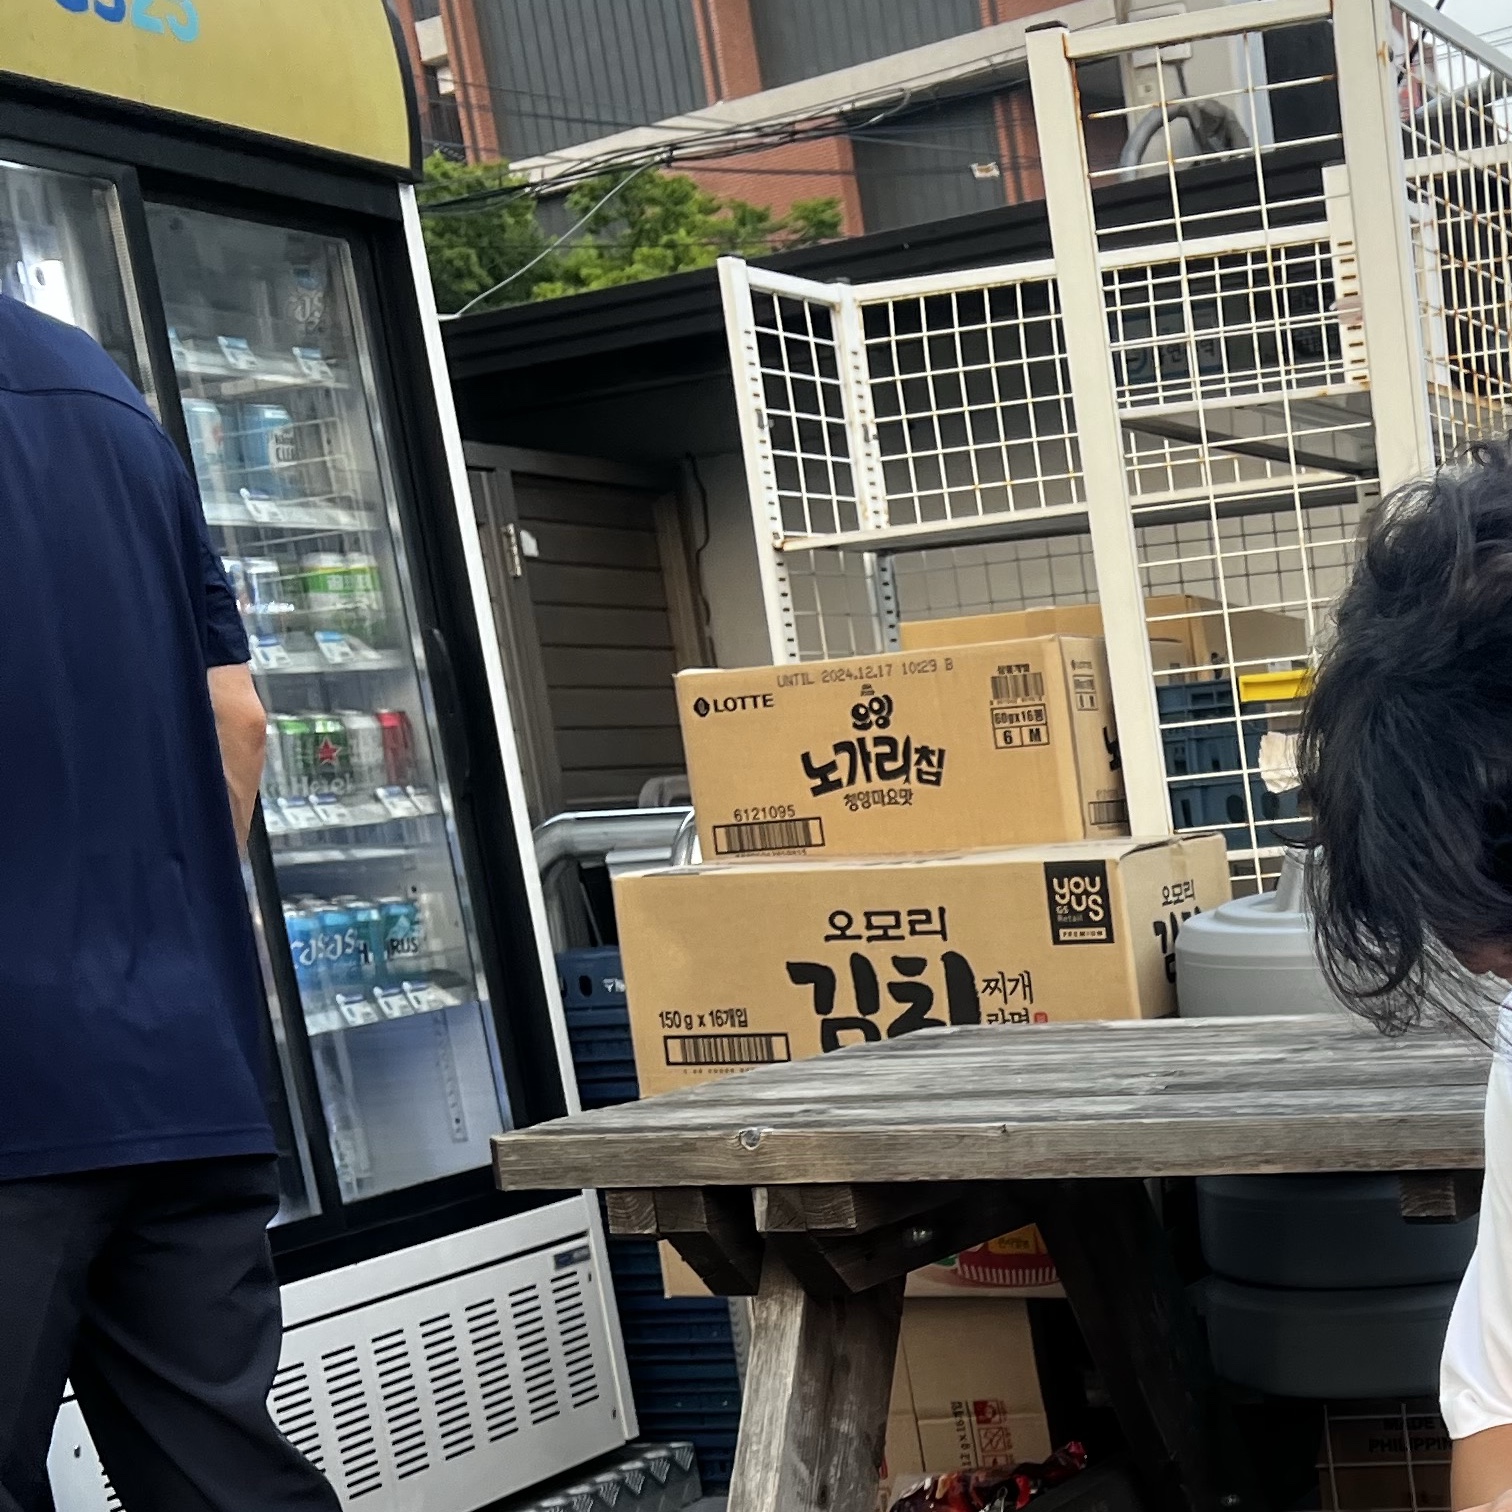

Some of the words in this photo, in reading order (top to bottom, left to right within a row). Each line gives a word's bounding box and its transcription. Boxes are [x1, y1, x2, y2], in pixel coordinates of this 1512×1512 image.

[777, 672, 815, 688] UNTIL
[821, 663, 893, 684] 2024.12.17
[713, 693, 775, 714] LOTTE
[1003, 729, 1013, 745] 6
[1029, 727, 1042, 742] M
[800, 735, 947, 798] 노가리칩
[843, 788, 914, 812] 청양마요맛
[1052, 875, 1101, 904] you
[1161, 878, 1197, 907] 오모리
[823, 906, 949, 943] 오모리
[786, 950, 981, 1054] 김치
[981, 970, 1034, 1005] 찌개
